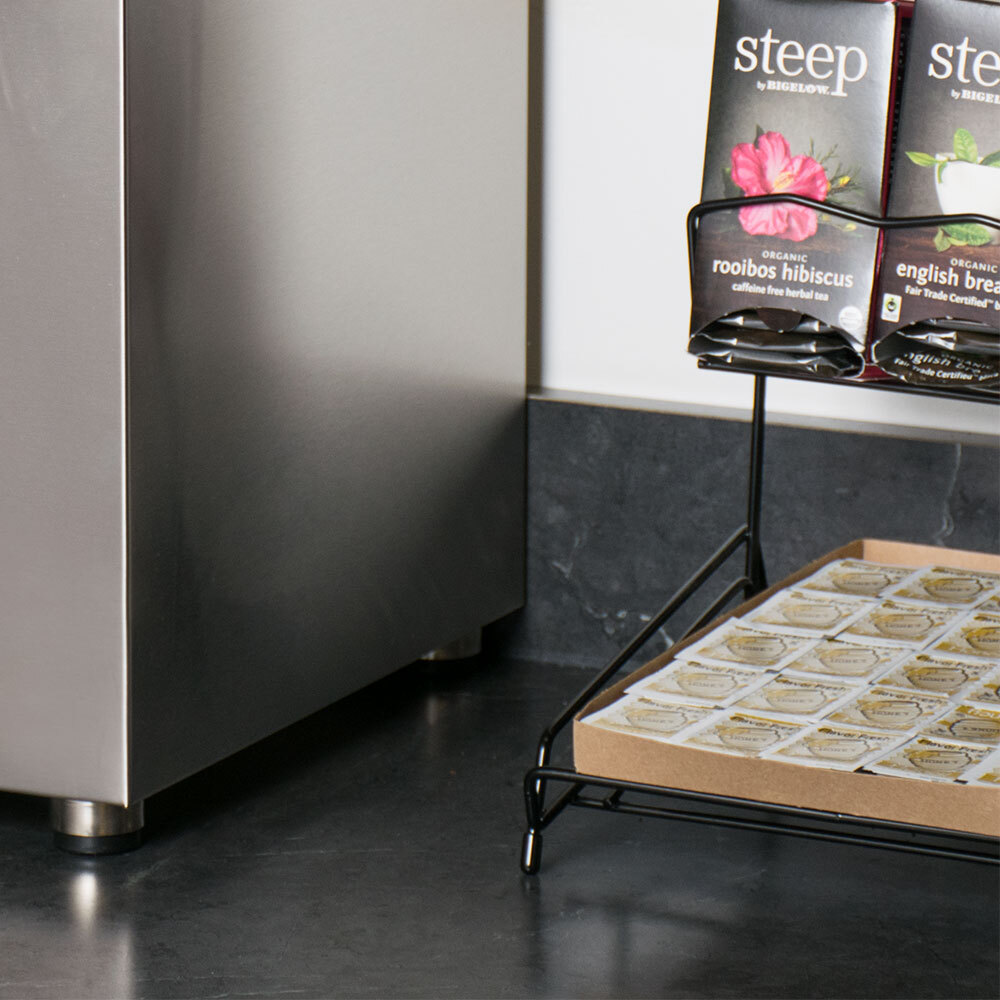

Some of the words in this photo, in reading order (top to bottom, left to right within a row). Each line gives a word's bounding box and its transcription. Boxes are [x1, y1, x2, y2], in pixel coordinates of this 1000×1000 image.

[734, 28, 868, 97] steep
[756, 81, 767, 92] by
[950, 88, 960, 100] by
[762, 250, 808, 263] ORGANIC
[949, 257, 998, 274] ORGANIC
[712, 258, 777, 280] rooibos
[781, 263, 854, 288] hibiscus
[896, 263, 960, 287] english
[732, 282, 766, 295] caffeine
[767, 284, 785, 297] free
[786, 286, 813, 300] herbal
[814, 289, 829, 302] tea
[904, 284, 922, 296] Fair
[923, 287, 949, 302] Trade
